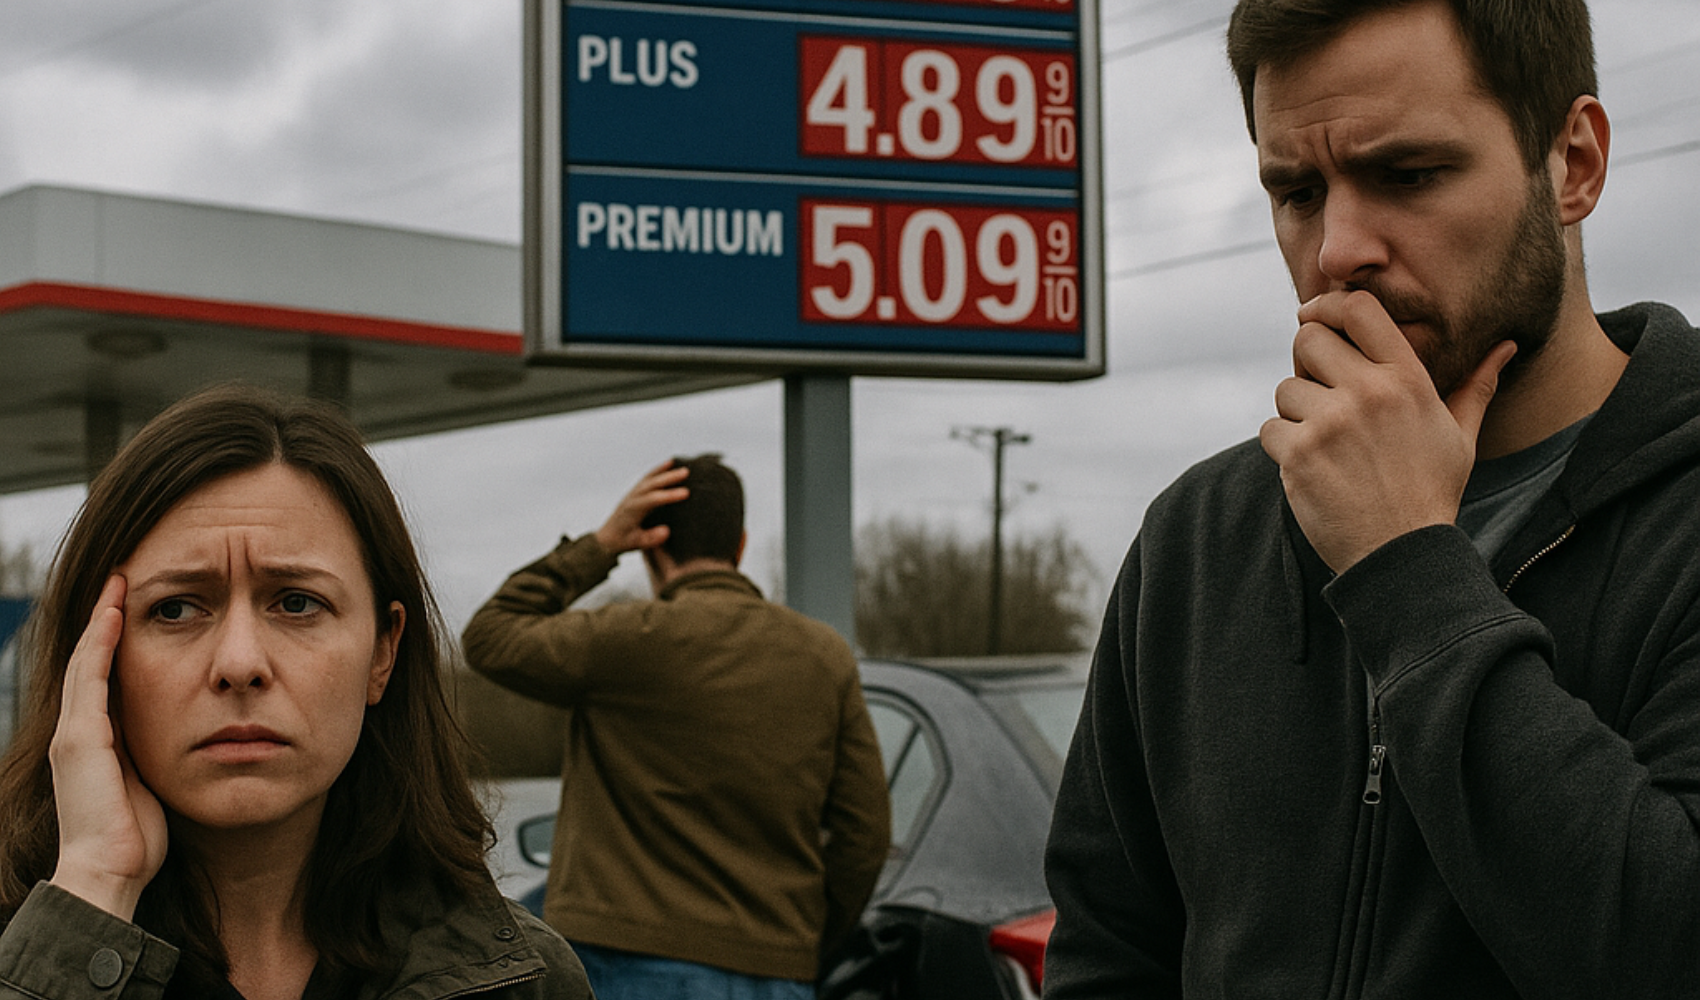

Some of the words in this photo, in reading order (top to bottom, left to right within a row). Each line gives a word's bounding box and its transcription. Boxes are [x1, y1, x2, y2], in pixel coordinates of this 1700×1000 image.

[579, 35, 699, 88] PLUS
[806, 45, 1037, 162] 4.89
[578, 203, 783, 256] PREMIUM
[811, 205, 1038, 323] 5.09
